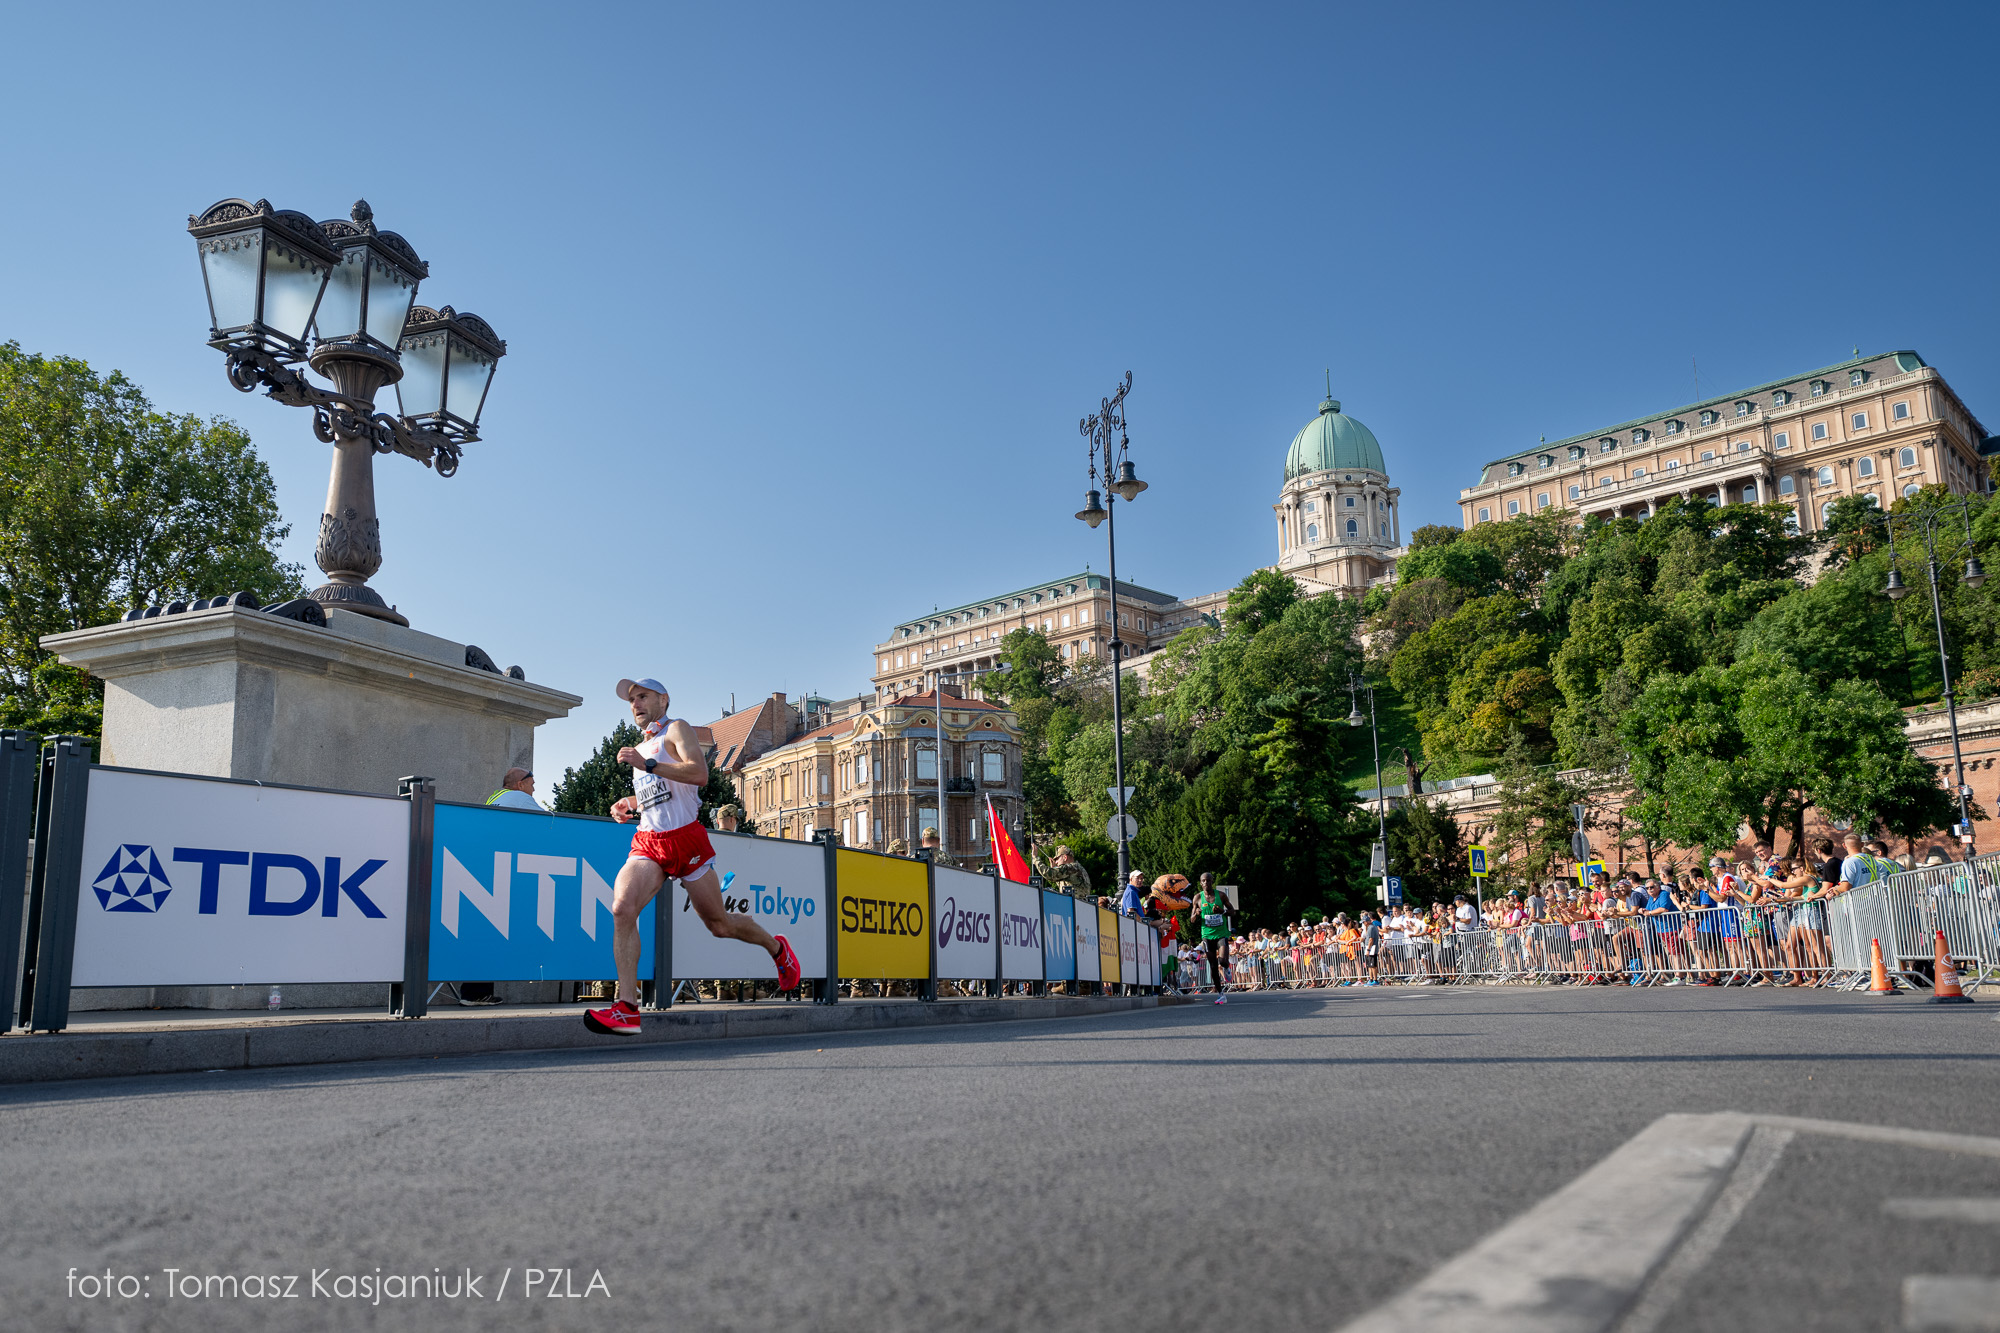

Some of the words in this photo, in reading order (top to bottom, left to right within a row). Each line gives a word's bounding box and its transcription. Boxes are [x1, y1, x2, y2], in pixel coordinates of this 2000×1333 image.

[637, 781, 667, 801] OWICKI
[173, 847, 388, 919] TDK
[749, 884, 816, 925] Tokyo
[841, 895, 923, 937] SEIKO
[956, 909, 991, 944] asics
[1010, 913, 1040, 949] TDK
[1044, 911, 1073, 960] NTN
